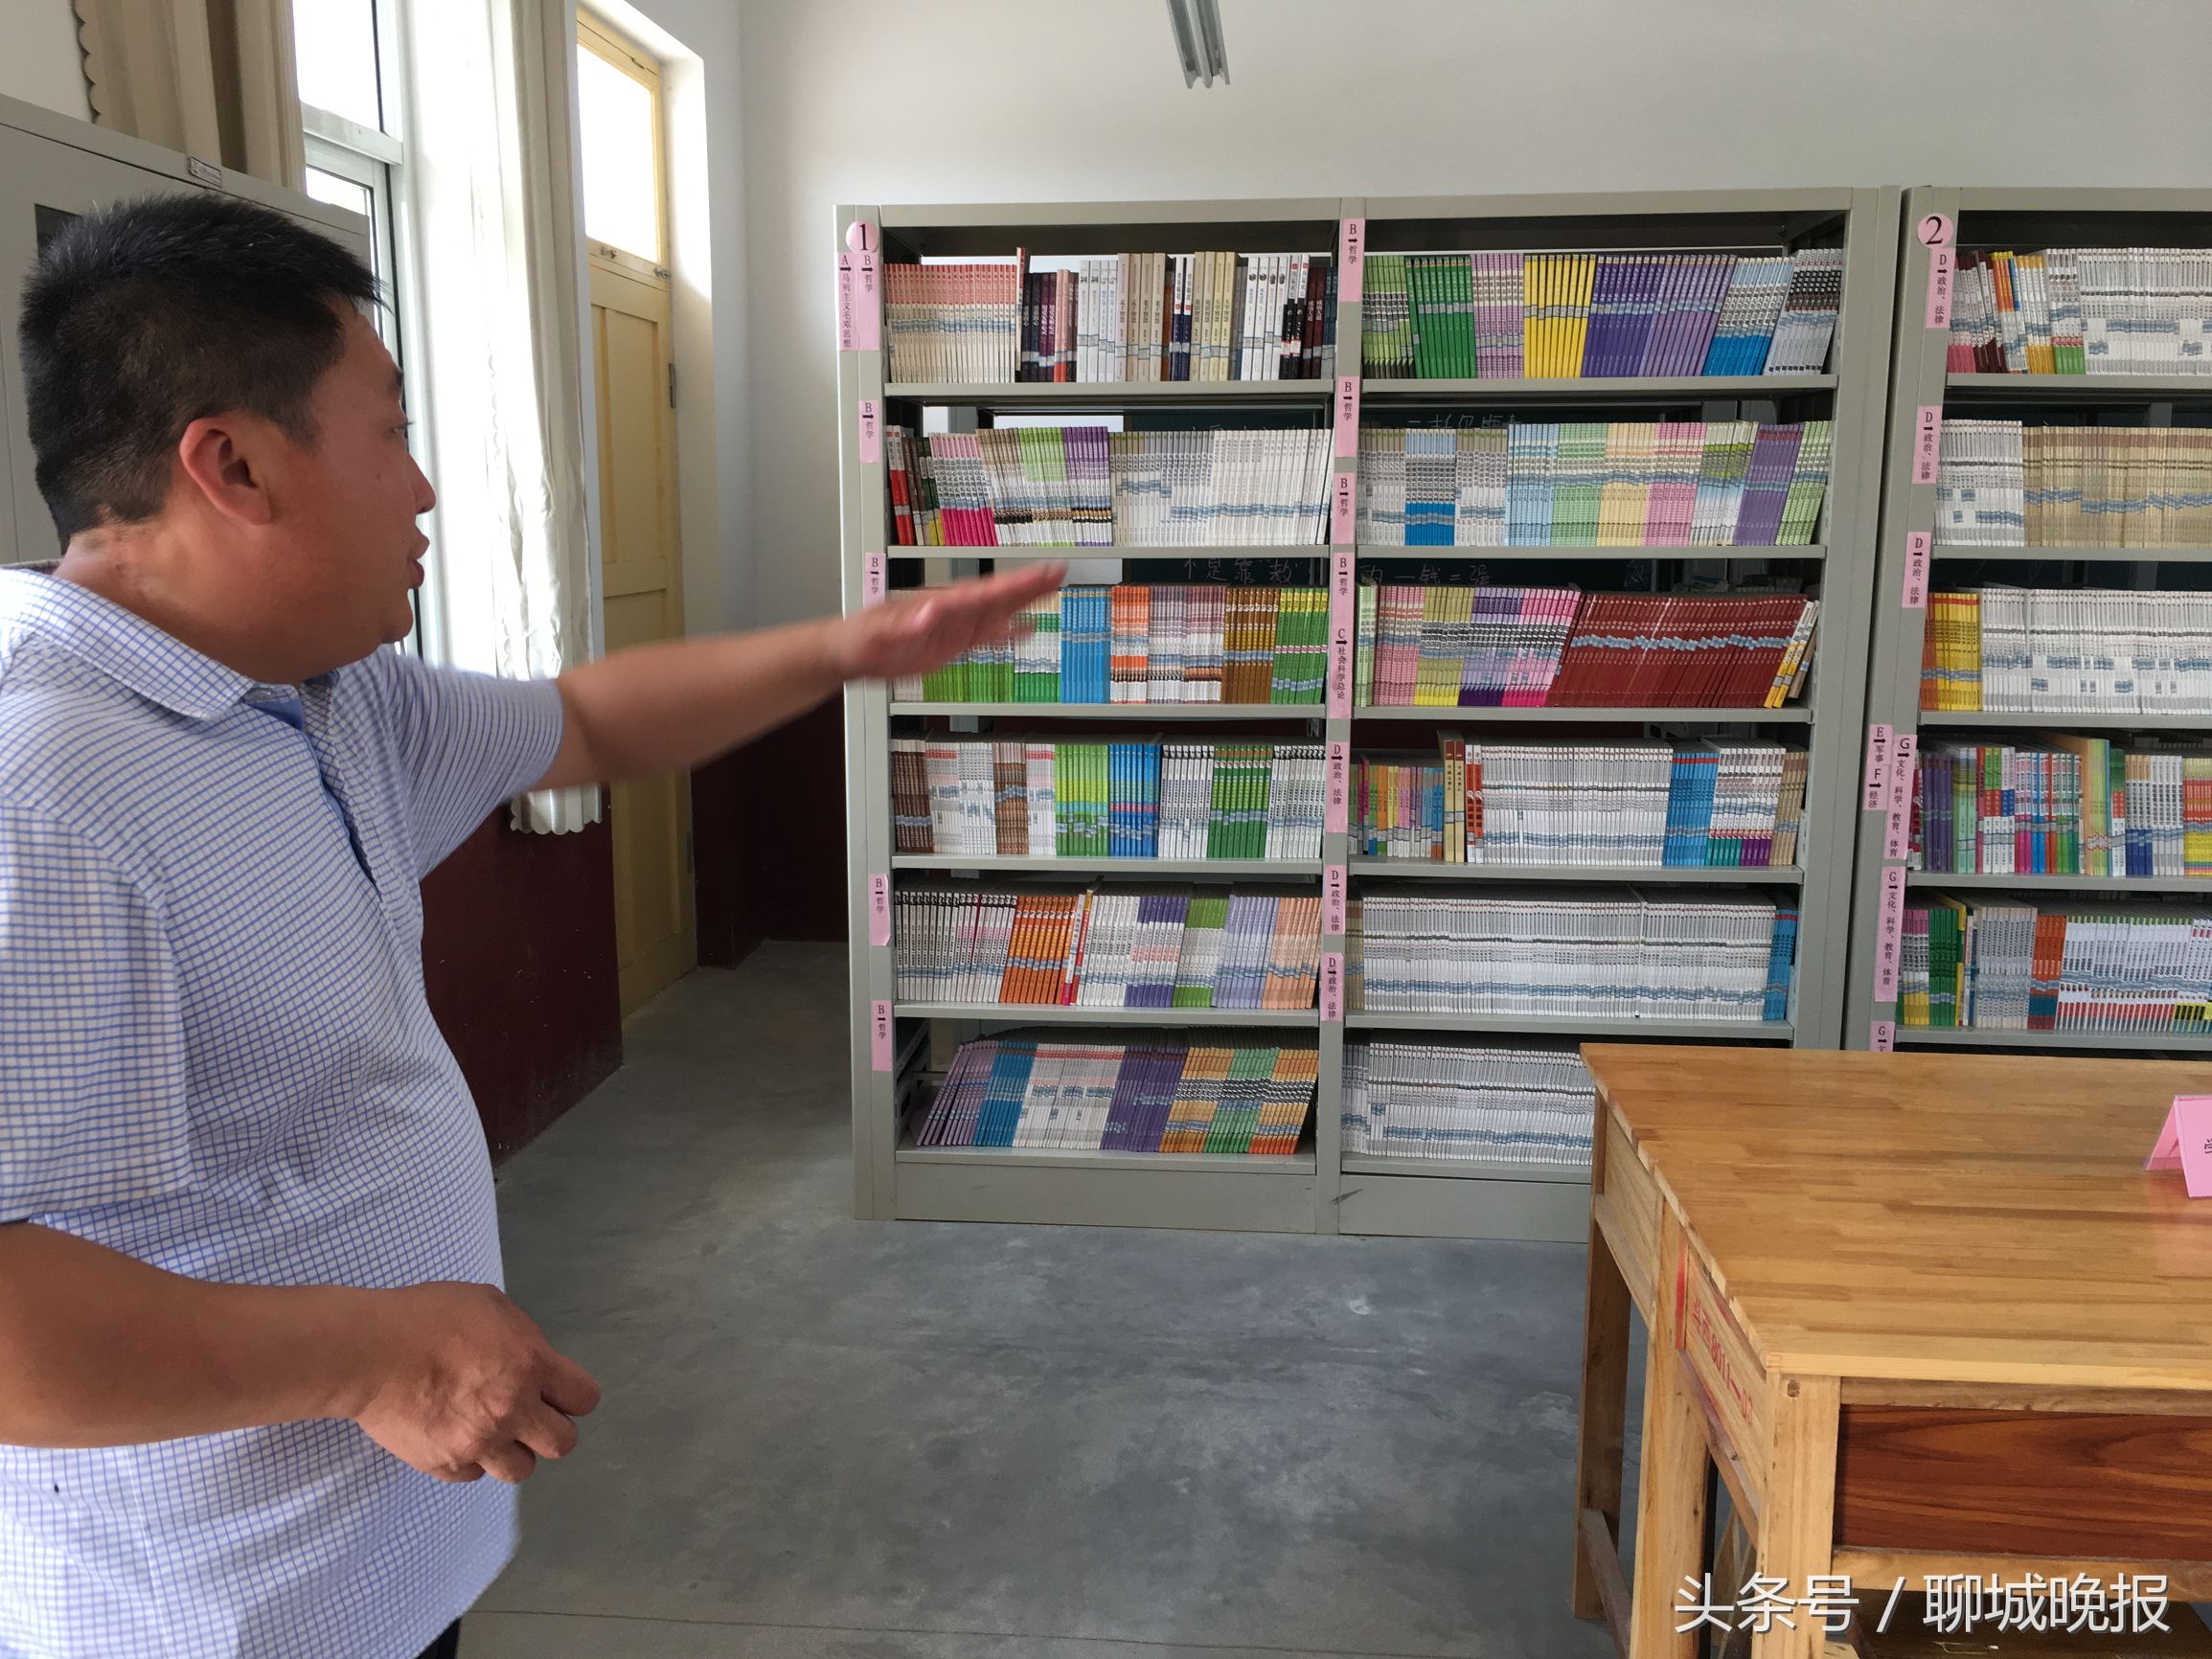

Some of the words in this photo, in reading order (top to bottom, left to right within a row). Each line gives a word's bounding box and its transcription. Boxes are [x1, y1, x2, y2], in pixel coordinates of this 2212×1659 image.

[1349, 223, 1357, 235] B
[1925, 216, 1944, 245] 2
[859, 222, 868, 251] 1
[841, 255, 849, 265] A
[864, 255, 872, 265] B
[1939, 254, 1947, 265] D
[1344, 381, 1352, 393] B
[865, 402, 873, 413] B
[1925, 412, 1933, 422] D
[1340, 478, 1348, 489] B
[1915, 538, 1923, 549] D
[872, 557, 878, 567] B
[1339, 557, 1347, 568] B
[1338, 628, 1346, 639] C
[1876, 727, 1884, 738] E
[1334, 744, 1341, 754] D
[1900, 738, 1910, 750] G
[1874, 768, 1881, 780] F
[1332, 870, 1339, 880] D
[1889, 872, 1897, 882] G
[876, 878, 883, 888] B
[1329, 958, 1336, 967] D
[878, 1005, 885, 1014] B
[1879, 1026, 1886, 1035] G
